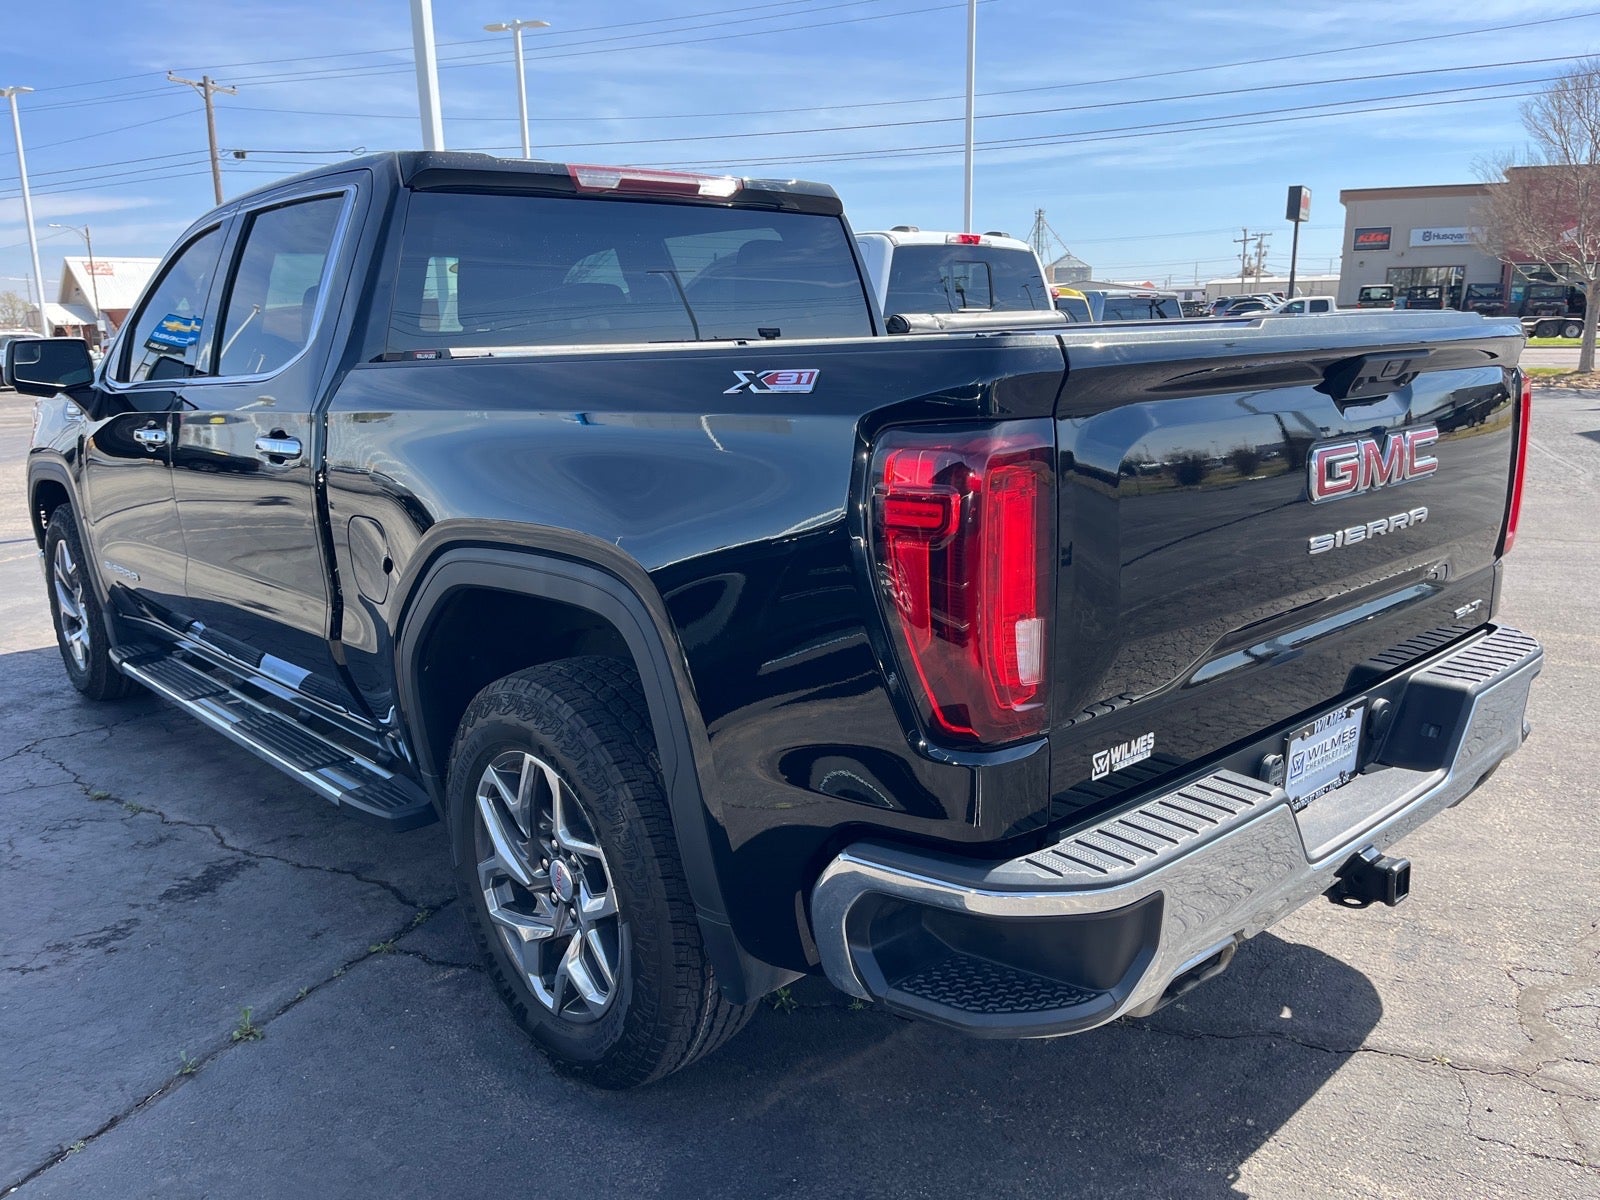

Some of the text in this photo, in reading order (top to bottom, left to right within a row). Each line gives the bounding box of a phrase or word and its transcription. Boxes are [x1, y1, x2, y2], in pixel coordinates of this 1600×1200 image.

[1308, 425, 1439, 504] GMC
[1308, 507, 1429, 555] SIERRA
[1110, 732, 1154, 765] WILMES
[1308, 727, 1357, 760] WILMES
